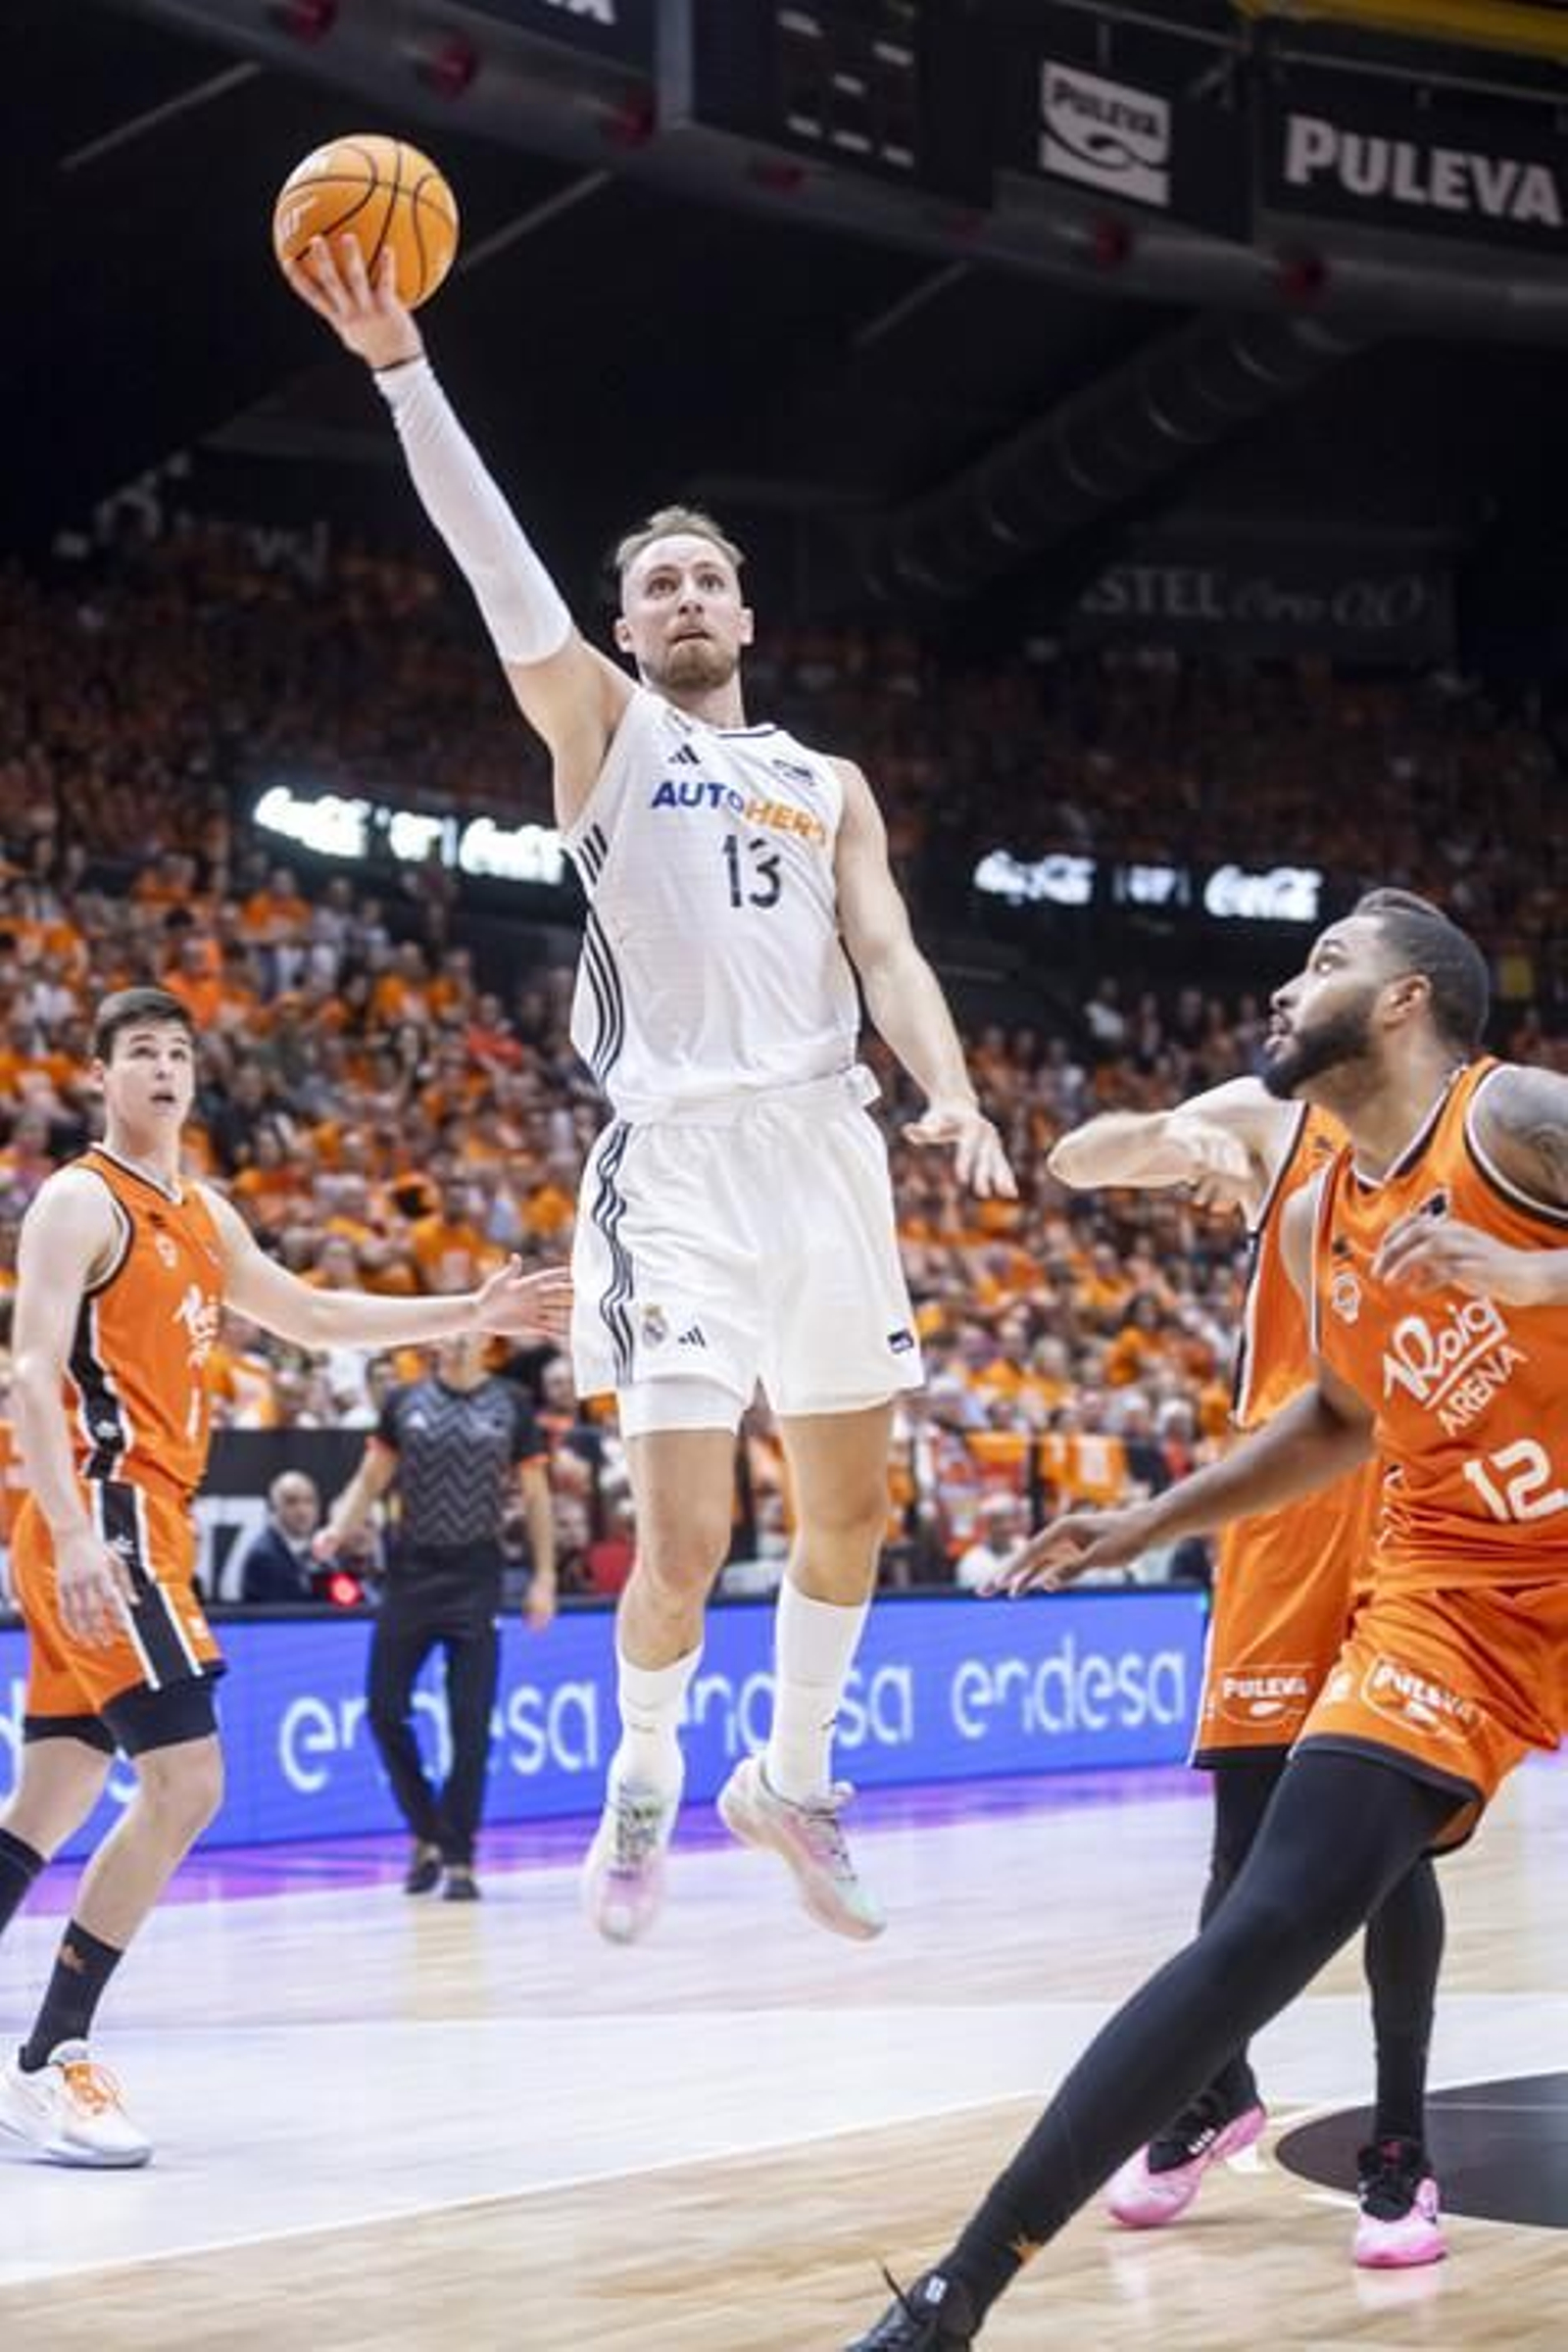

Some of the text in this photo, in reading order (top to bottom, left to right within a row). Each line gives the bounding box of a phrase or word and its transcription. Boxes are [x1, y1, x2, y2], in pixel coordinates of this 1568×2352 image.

[1052, 77, 1159, 138] PULEVA
[1284, 112, 1564, 225] PULEVA
[724, 834, 781, 907] 13
[1437, 1344, 1529, 1437] ARENA
[1463, 1439, 1568, 1521] 12
[952, 1637, 1186, 1739] endesa
